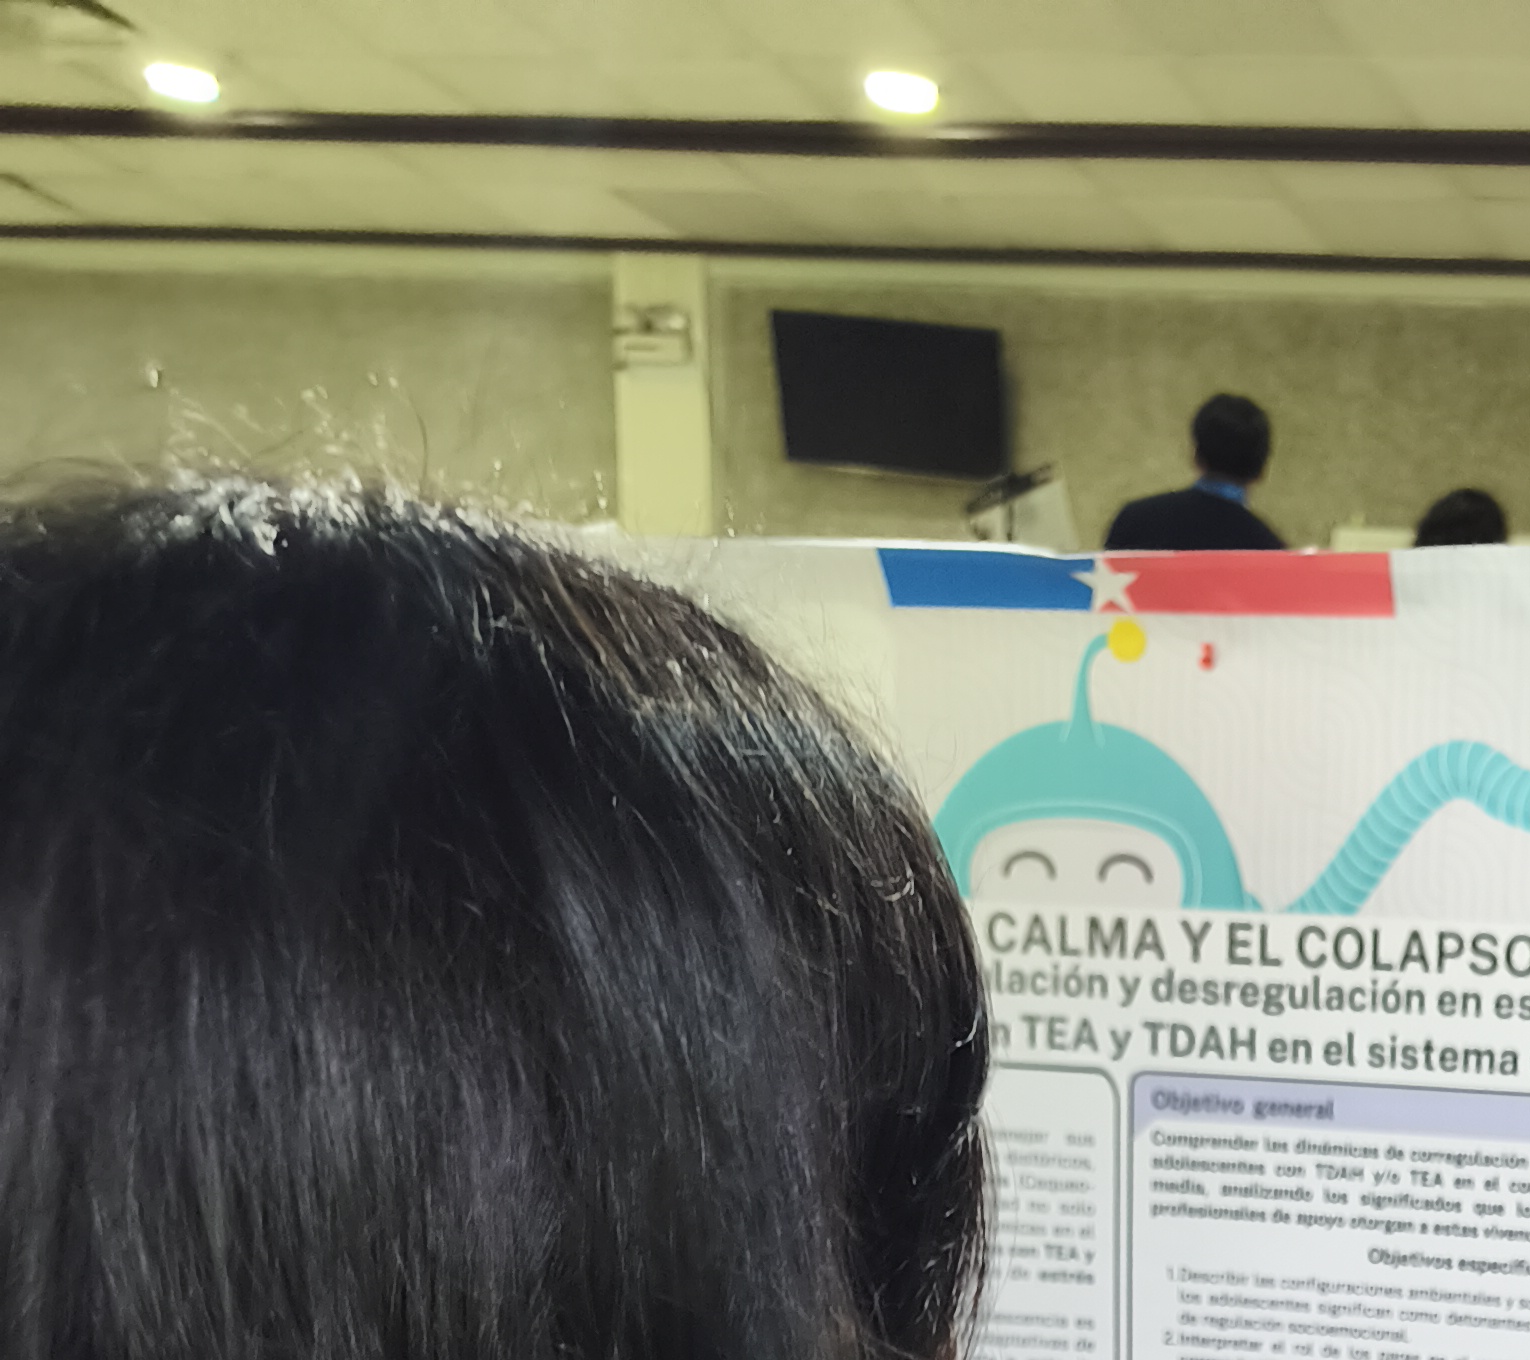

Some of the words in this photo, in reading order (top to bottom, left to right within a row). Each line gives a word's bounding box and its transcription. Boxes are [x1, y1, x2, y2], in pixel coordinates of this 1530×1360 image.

[987, 912, 1165, 962] CALMA
[1180, 920, 1212, 964] Y
[1227, 922, 1283, 967] EL
[985, 965, 1109, 999] lación
[1119, 974, 1141, 1007] y
[1151, 969, 1426, 1016] desregulación
[1437, 988, 1481, 1018] en
[1021, 1014, 1098, 1053] TEA
[1109, 1029, 1132, 1061] y
[1143, 1021, 1257, 1063] TDAH
[1267, 1035, 1310, 1065] en
[1323, 1033, 1355, 1067] el
[1367, 1035, 1519, 1077] sistema
[1153, 1090, 1245, 1116] Objetivo
[1253, 1098, 1334, 1120] general
[1410, 1170, 1442, 1187] TEA
[1368, 1246, 1452, 1269] Objetivos
